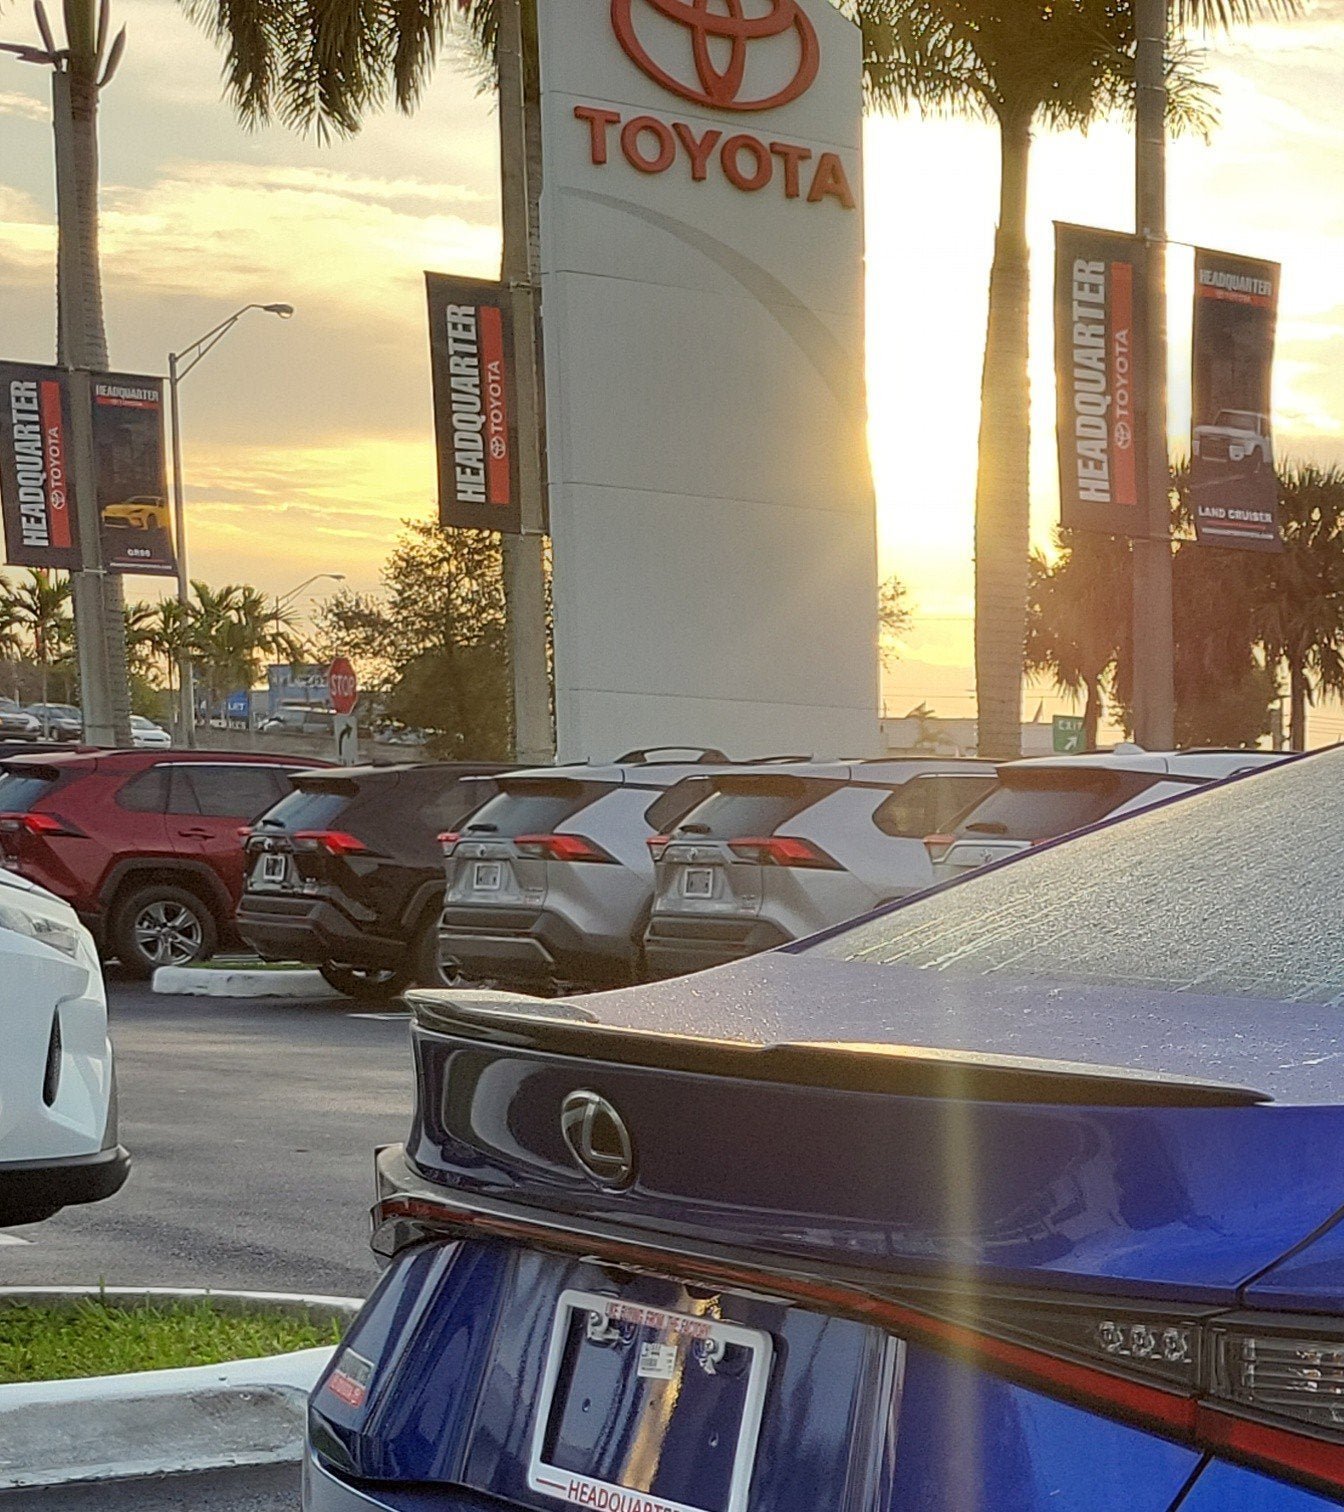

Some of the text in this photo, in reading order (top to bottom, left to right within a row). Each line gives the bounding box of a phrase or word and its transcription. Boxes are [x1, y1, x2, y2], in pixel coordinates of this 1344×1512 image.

[573, 105, 856, 209] TOYOTA
[446, 304, 486, 503] HEADQUARTER
[487, 360, 503, 433] TOYOTA
[1072, 257, 1112, 502] HEADQUARTER
[1114, 328, 1131, 419] TOYOTA
[10, 380, 49, 547] HEADQUARTER
[49, 426, 63, 489] TOYOTA
[1198, 505, 1273, 523] LAND CRUISER
[331, 673, 355, 697] STOP
